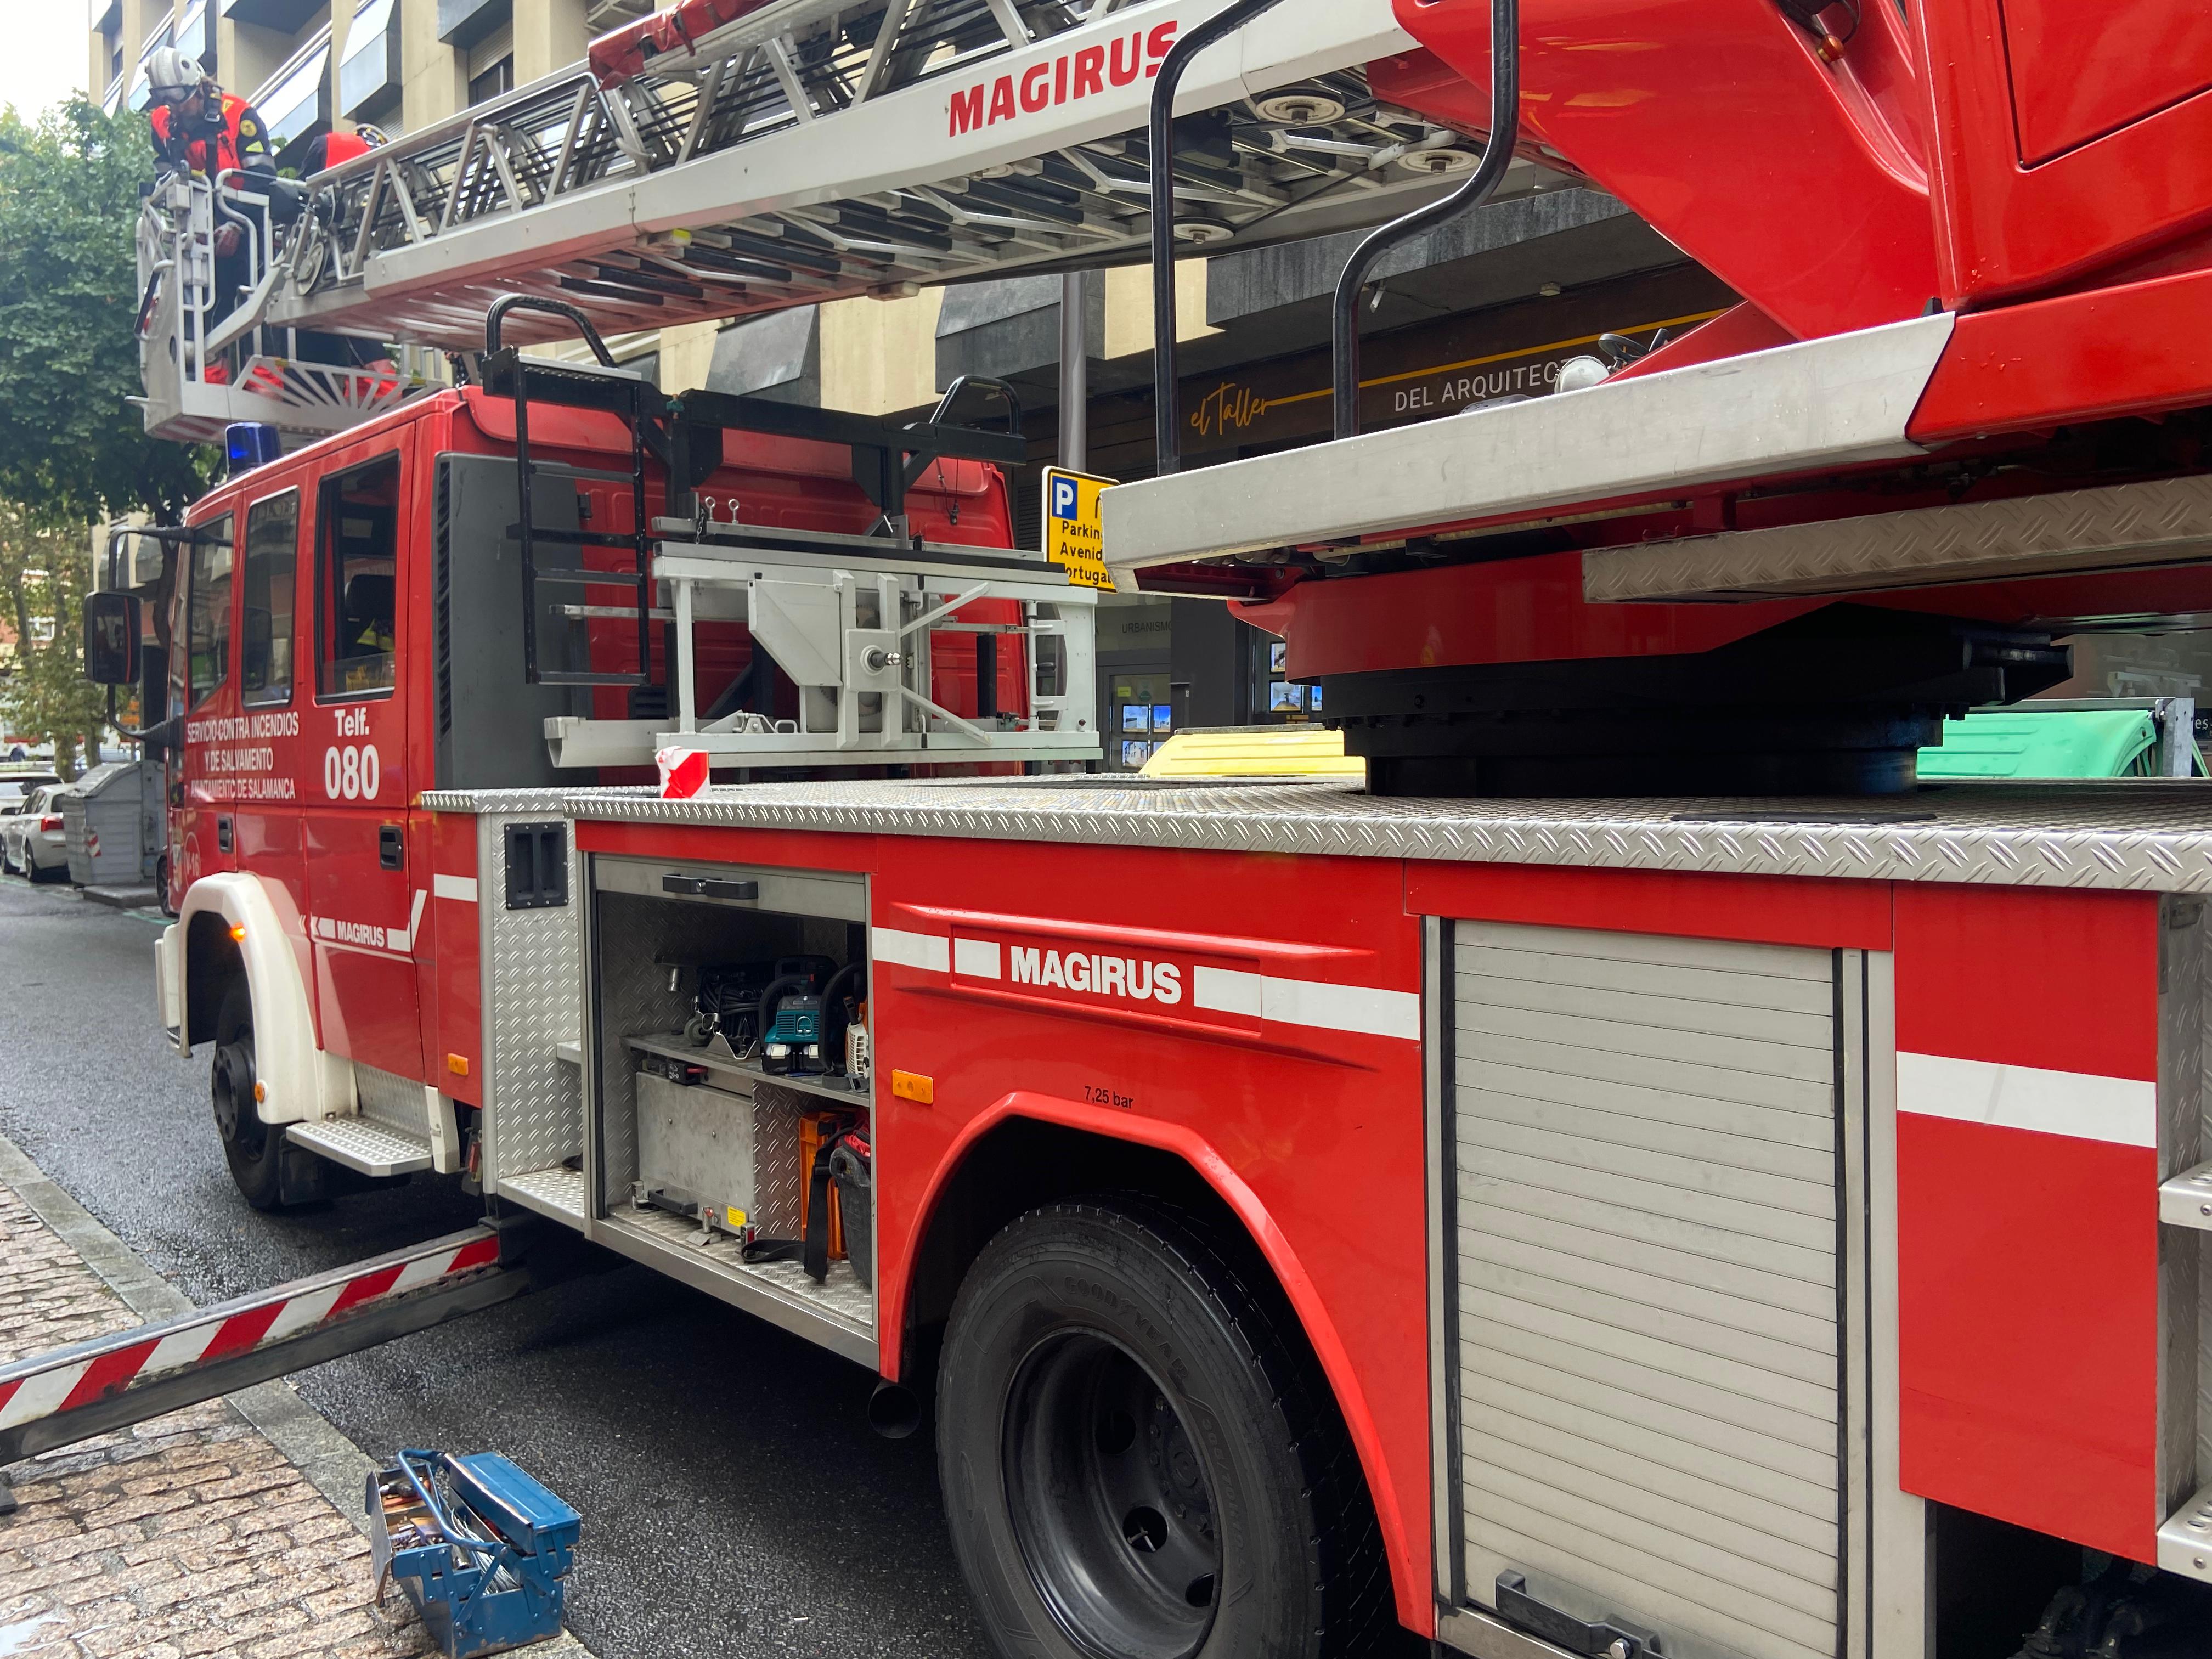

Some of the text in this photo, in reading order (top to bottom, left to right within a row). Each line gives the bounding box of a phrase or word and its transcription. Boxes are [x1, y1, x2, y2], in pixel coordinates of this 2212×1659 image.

[949, 20, 1178, 138] MAGIRUS
[1190, 382, 1268, 435] el Taller
[1395, 387, 1434, 411] DEL
[1056, 482, 1074, 515] P
[1062, 520, 1102, 543] Parkin
[187, 711, 299, 743] SERVICIO CONTRA INCENDIOS
[335, 707, 370, 737] Telf.
[205, 747, 273, 772] Y DE SALVAMENTO
[325, 744, 380, 800] 080
[237, 778, 247, 799] DE
[249, 778, 296, 800] SALAMANCA
[337, 920, 385, 948] MAGIRUS
[1011, 945, 1182, 1005] MAGIRUS
[1085, 1086, 1134, 1109] 7,25 bar
